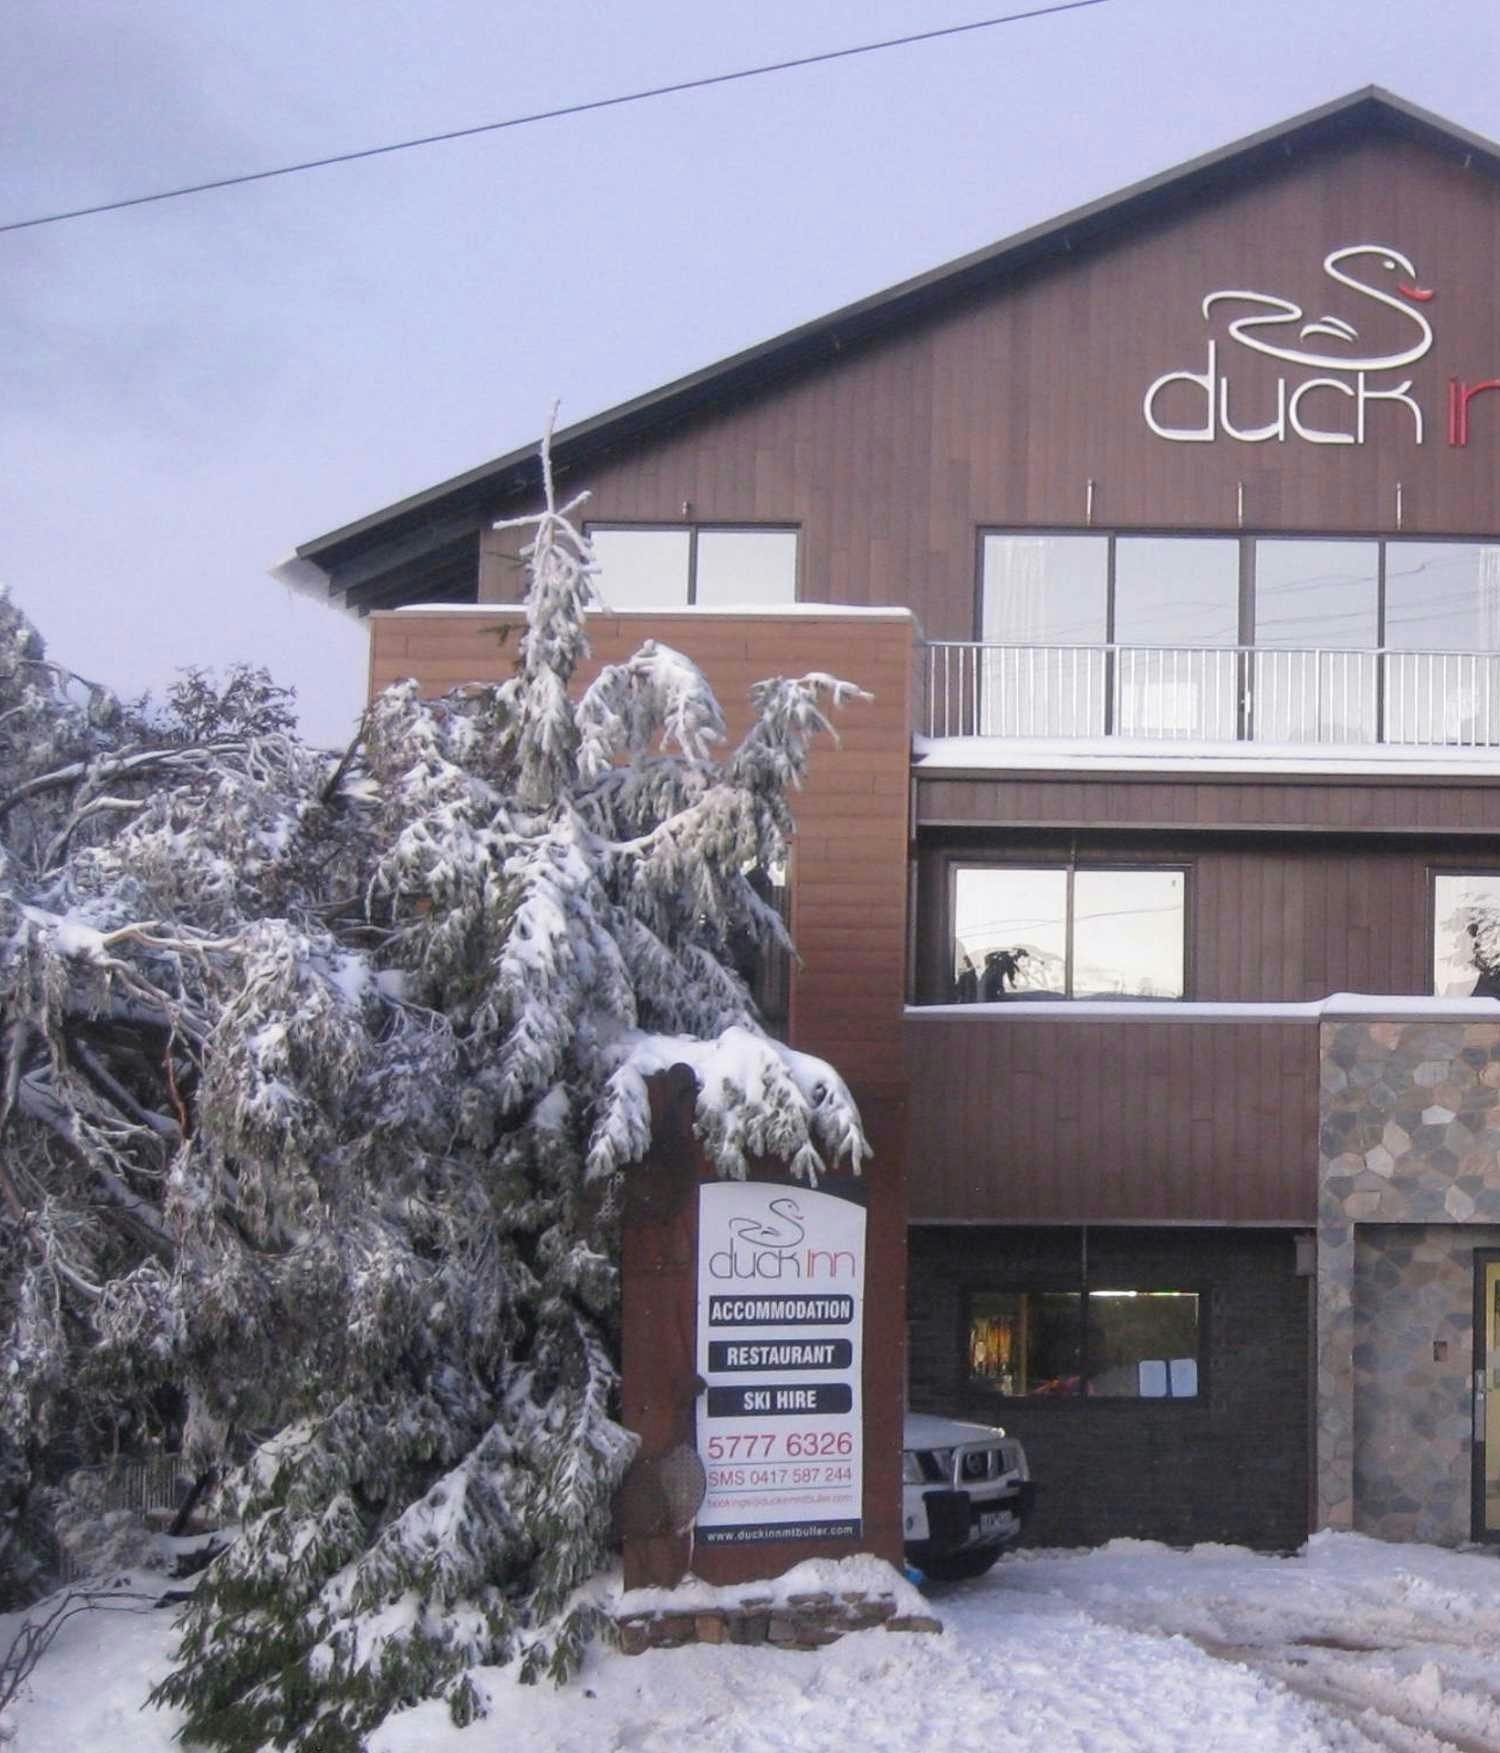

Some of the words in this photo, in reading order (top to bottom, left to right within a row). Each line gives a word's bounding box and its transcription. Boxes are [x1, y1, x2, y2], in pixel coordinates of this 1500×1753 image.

[1143, 339, 1424, 445] duck
[708, 1237, 801, 1279] duck
[806, 1248, 856, 1279] inn
[711, 1300, 850, 1321] ACCOMMODATION
[726, 1345, 835, 1367] RESTAURANT
[743, 1390, 771, 1411] SKI
[776, 1389, 817, 1409] HIRE
[707, 1434, 777, 1460] 5777
[786, 1431, 853, 1457] 6326
[708, 1470, 746, 1488] SMS
[749, 1469, 789, 1486] 0417
[792, 1467, 820, 1484] 587
[824, 1466, 853, 1483] 244
[707, 1525, 854, 1542] www.duckinnmtbuller.com
